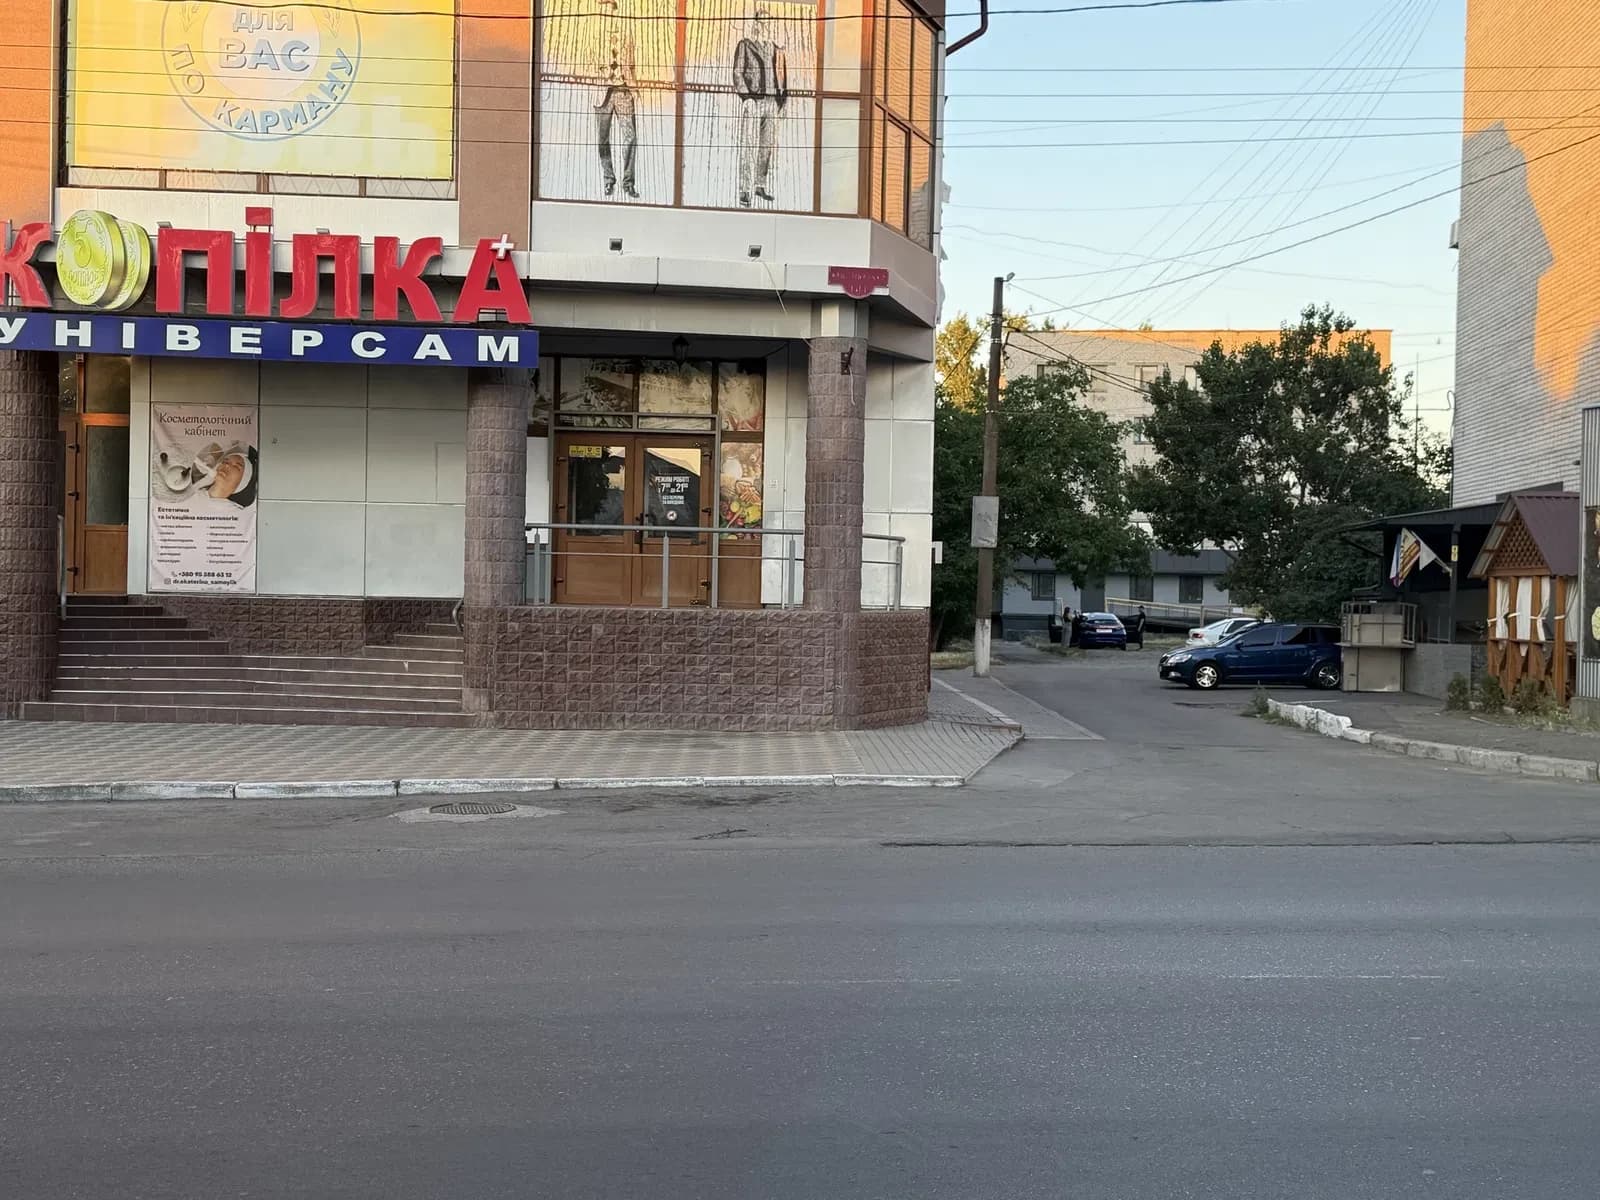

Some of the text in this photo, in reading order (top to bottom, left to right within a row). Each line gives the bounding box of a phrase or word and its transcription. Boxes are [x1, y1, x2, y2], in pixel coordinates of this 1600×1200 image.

[233, 9, 294, 33] ДЛЯ
[218, 38, 310, 72] ВАС
[171, 43, 353, 134] ПО КАРМАНУ
[0, 317, 519, 363] УНІВЕРСАМ
[159, 412, 252, 425] Косметологічний
[184, 425, 226, 437] кабінет
